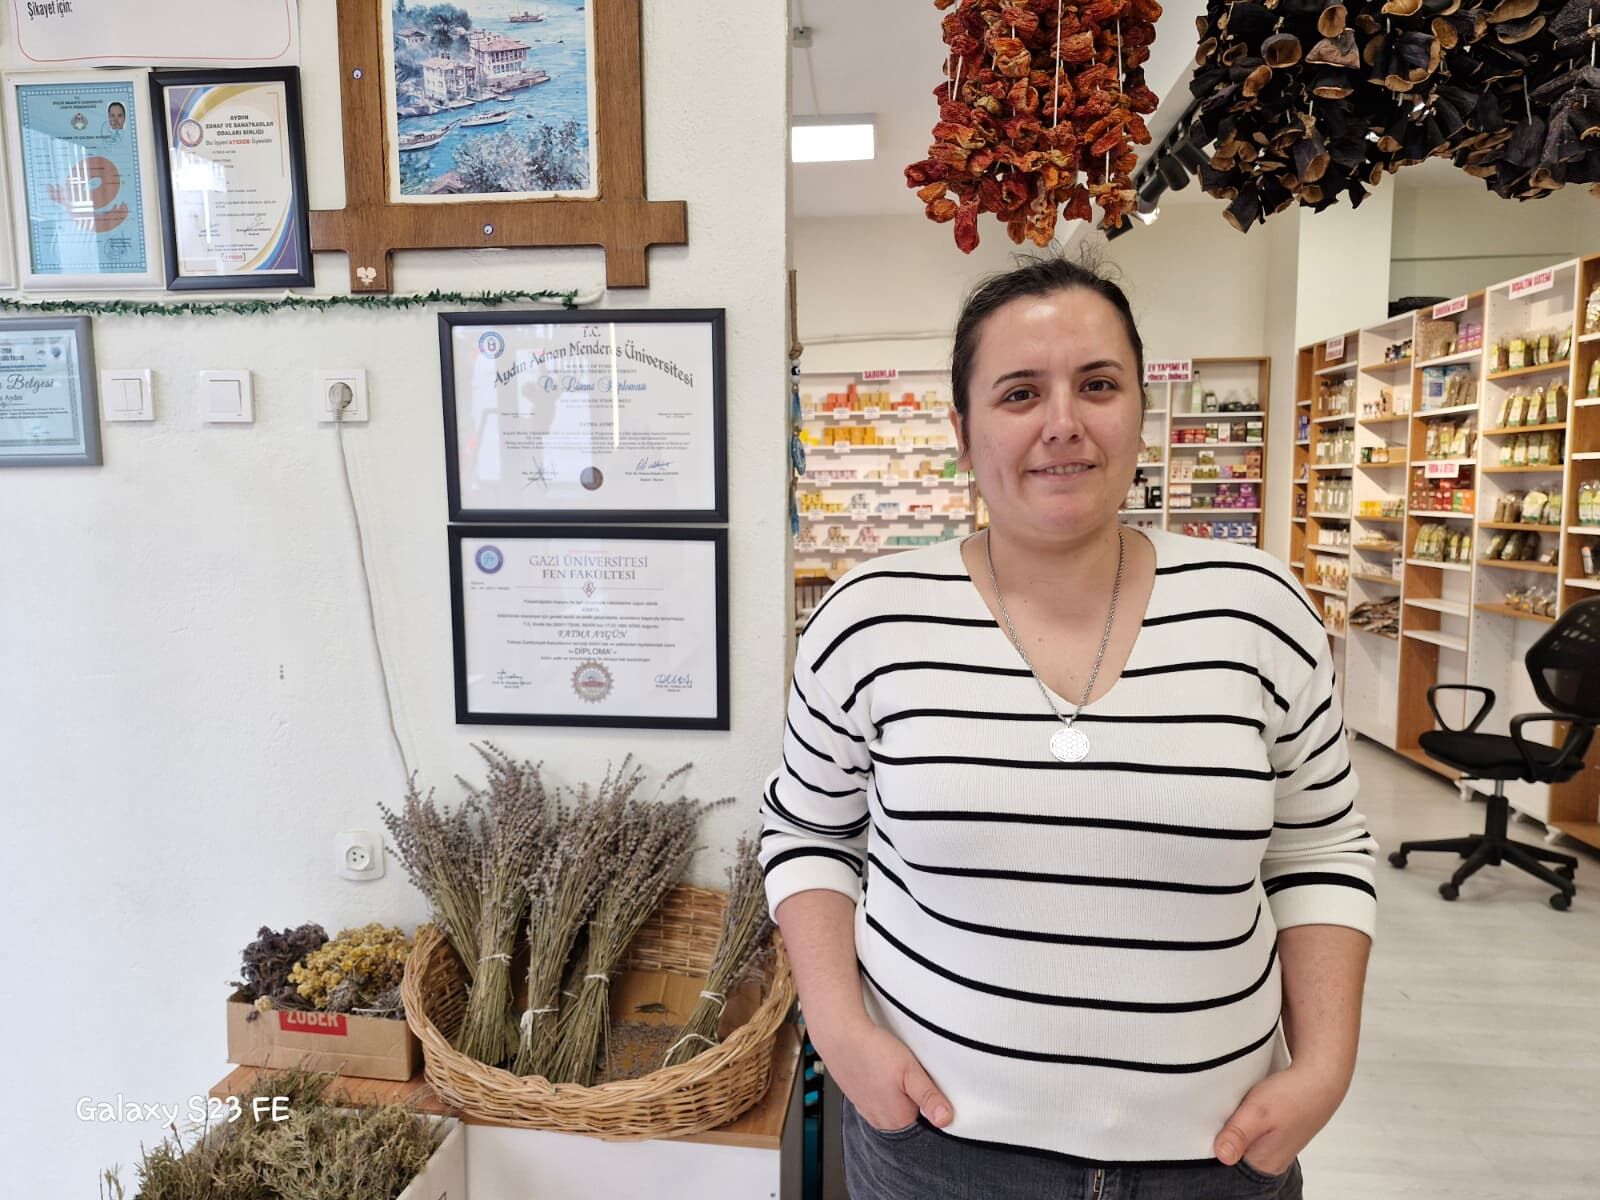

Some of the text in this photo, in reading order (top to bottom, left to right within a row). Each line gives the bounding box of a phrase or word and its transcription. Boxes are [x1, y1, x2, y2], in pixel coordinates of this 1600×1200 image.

[568, 339, 623, 358] Menders
[624, 339, 694, 388] Üniversitesi
[7, 373, 54, 393] Belgesi
[529, 553, 648, 568] GAZİ ÜNİVERSİTESİ
[542, 567, 636, 580] FEN FAKÜLTESİ
